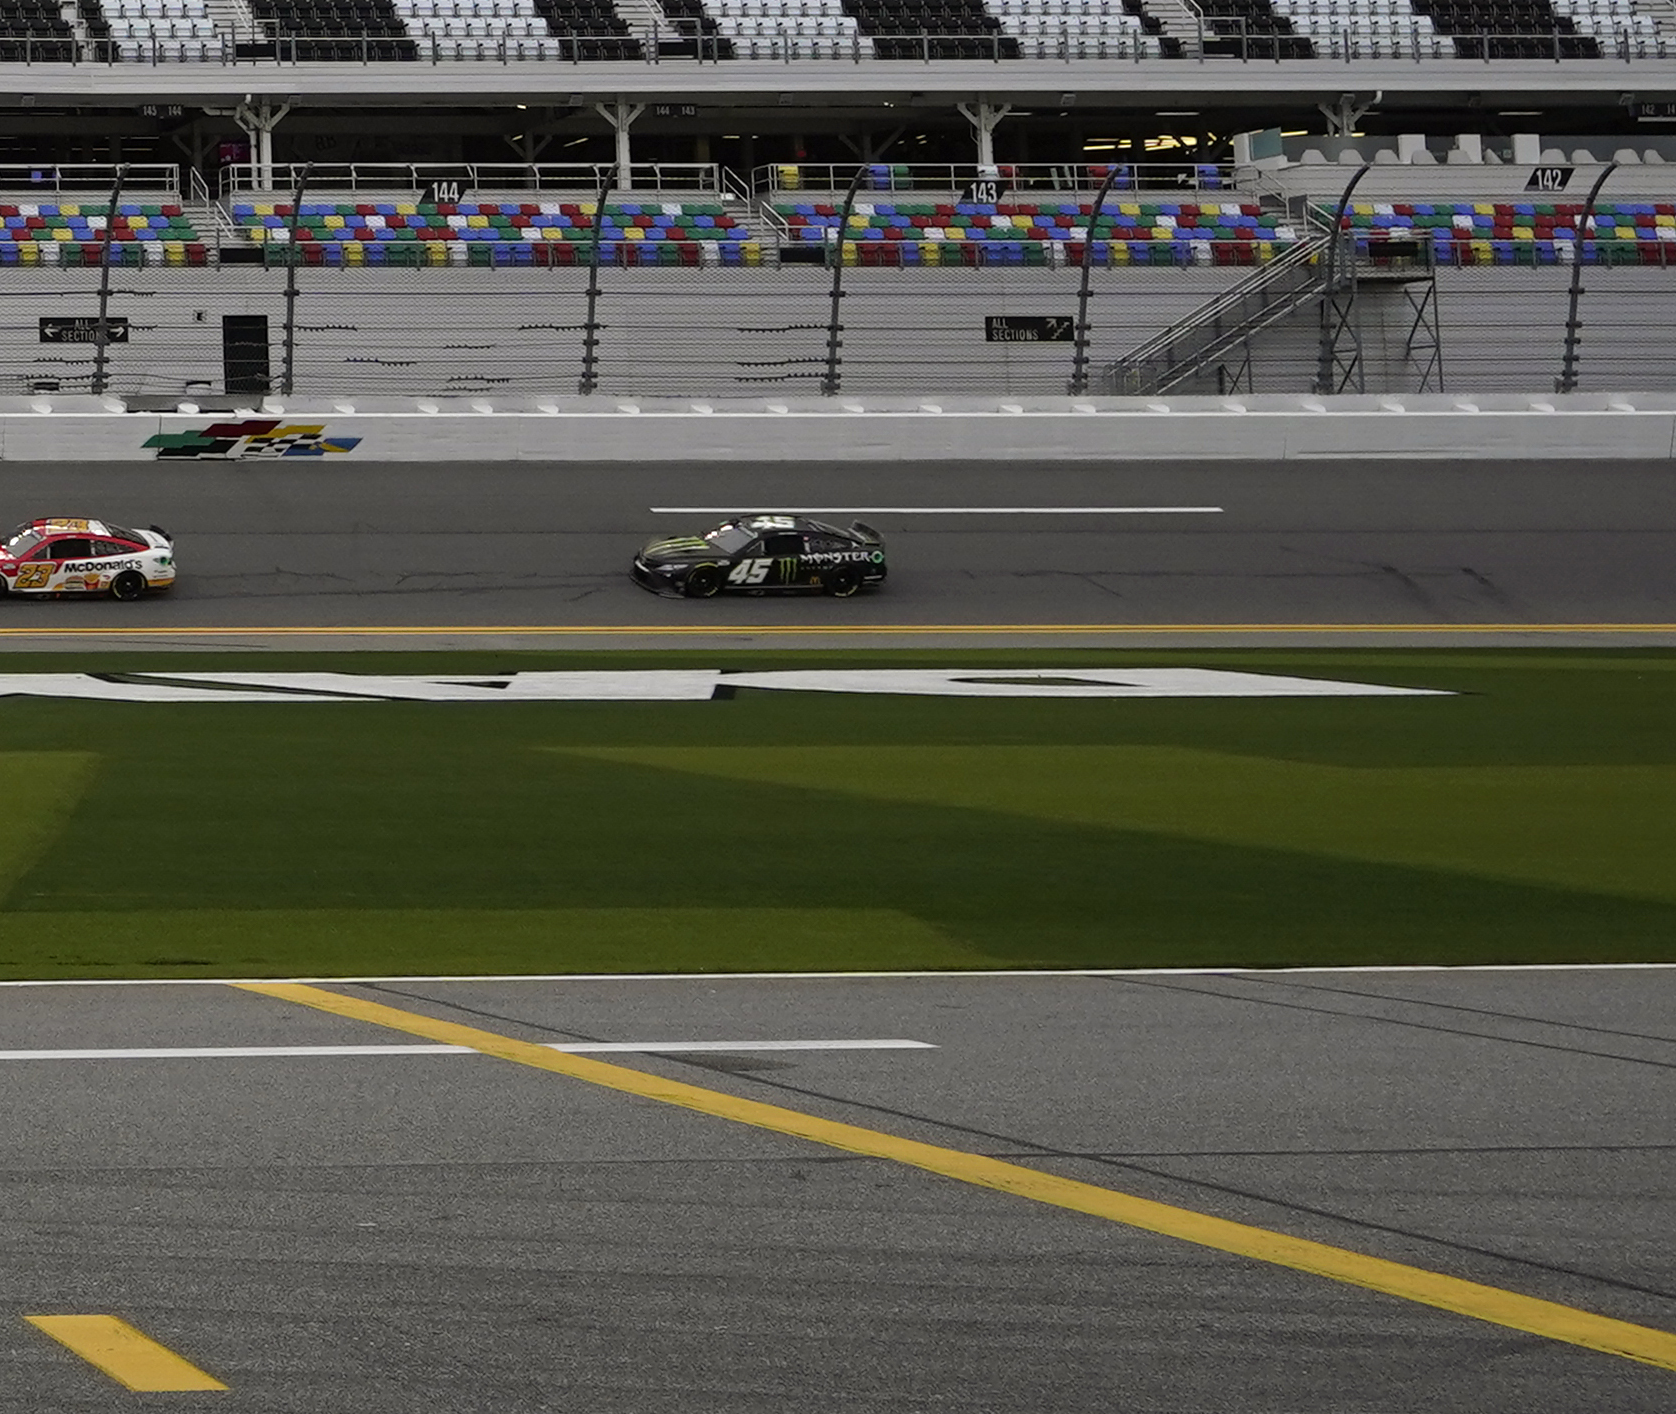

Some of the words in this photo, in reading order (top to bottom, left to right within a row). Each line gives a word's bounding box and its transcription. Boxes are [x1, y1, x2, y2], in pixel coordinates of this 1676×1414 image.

[1667, 104, 1676, 116] 14
[1535, 168, 1564, 191] 142
[431, 181, 460, 203] 144
[970, 181, 997, 204] 143
[74, 319, 91, 330] ALL
[992, 317, 1009, 329] ALL
[991, 329, 1039, 341] SECTIONS
[800, 549, 871, 565] MONSTER
[63, 558, 143, 574] McDonald's
[727, 558, 773, 585] 45
[13, 562, 57, 589] 23
